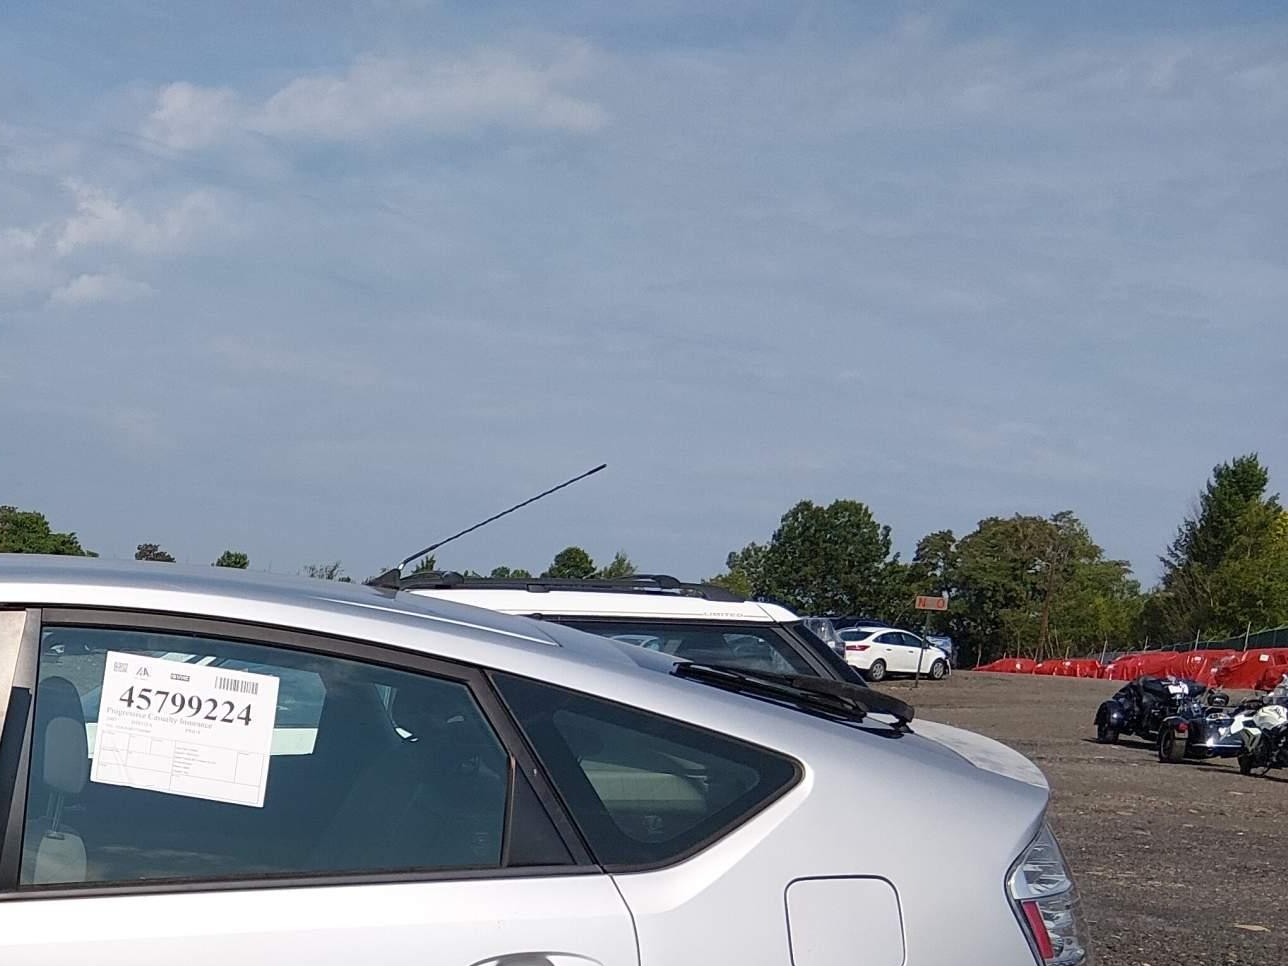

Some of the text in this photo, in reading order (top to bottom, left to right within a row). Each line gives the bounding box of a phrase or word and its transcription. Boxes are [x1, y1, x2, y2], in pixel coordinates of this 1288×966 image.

[918, 597, 926, 608] N
[119, 685, 252, 726] 45799224
[106, 706, 147, 719] Progressive
[147, 712, 178, 725] Casualty
[179, 717, 213, 729] Insurance
